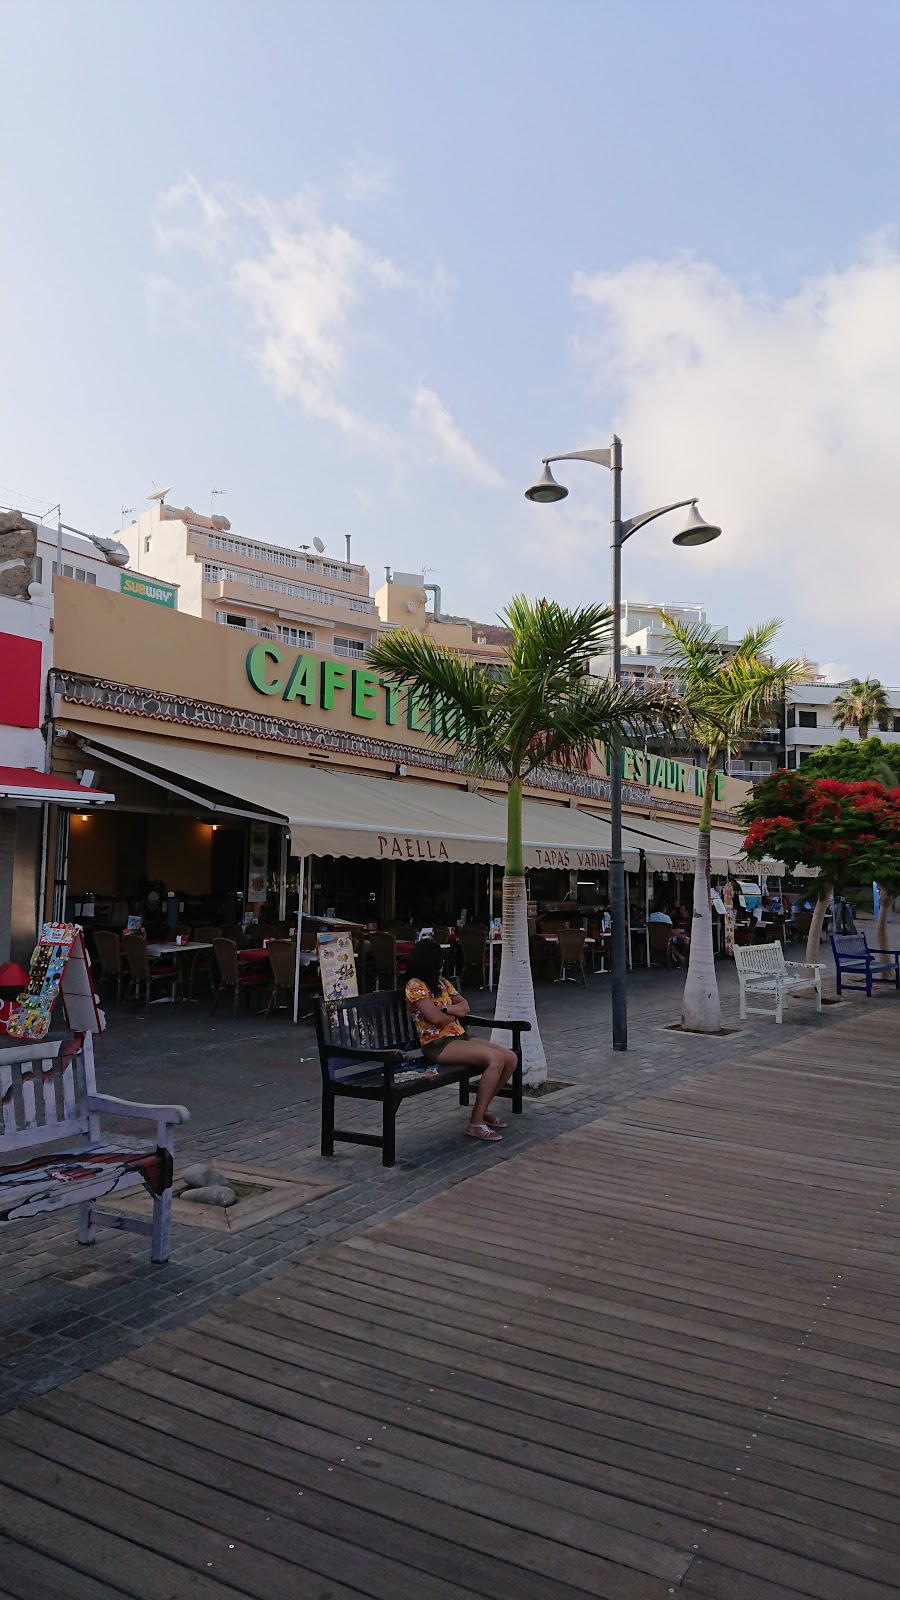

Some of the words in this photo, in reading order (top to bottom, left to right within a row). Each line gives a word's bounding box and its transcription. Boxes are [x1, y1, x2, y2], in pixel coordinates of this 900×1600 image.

[123, 579, 173, 602] SUBWAY
[606, 744, 725, 801] ESTAURANE
[378, 835, 449, 859] PAELLA
[535, 849, 570, 866] TAPAS
[665, 857, 691, 871] VARIED
